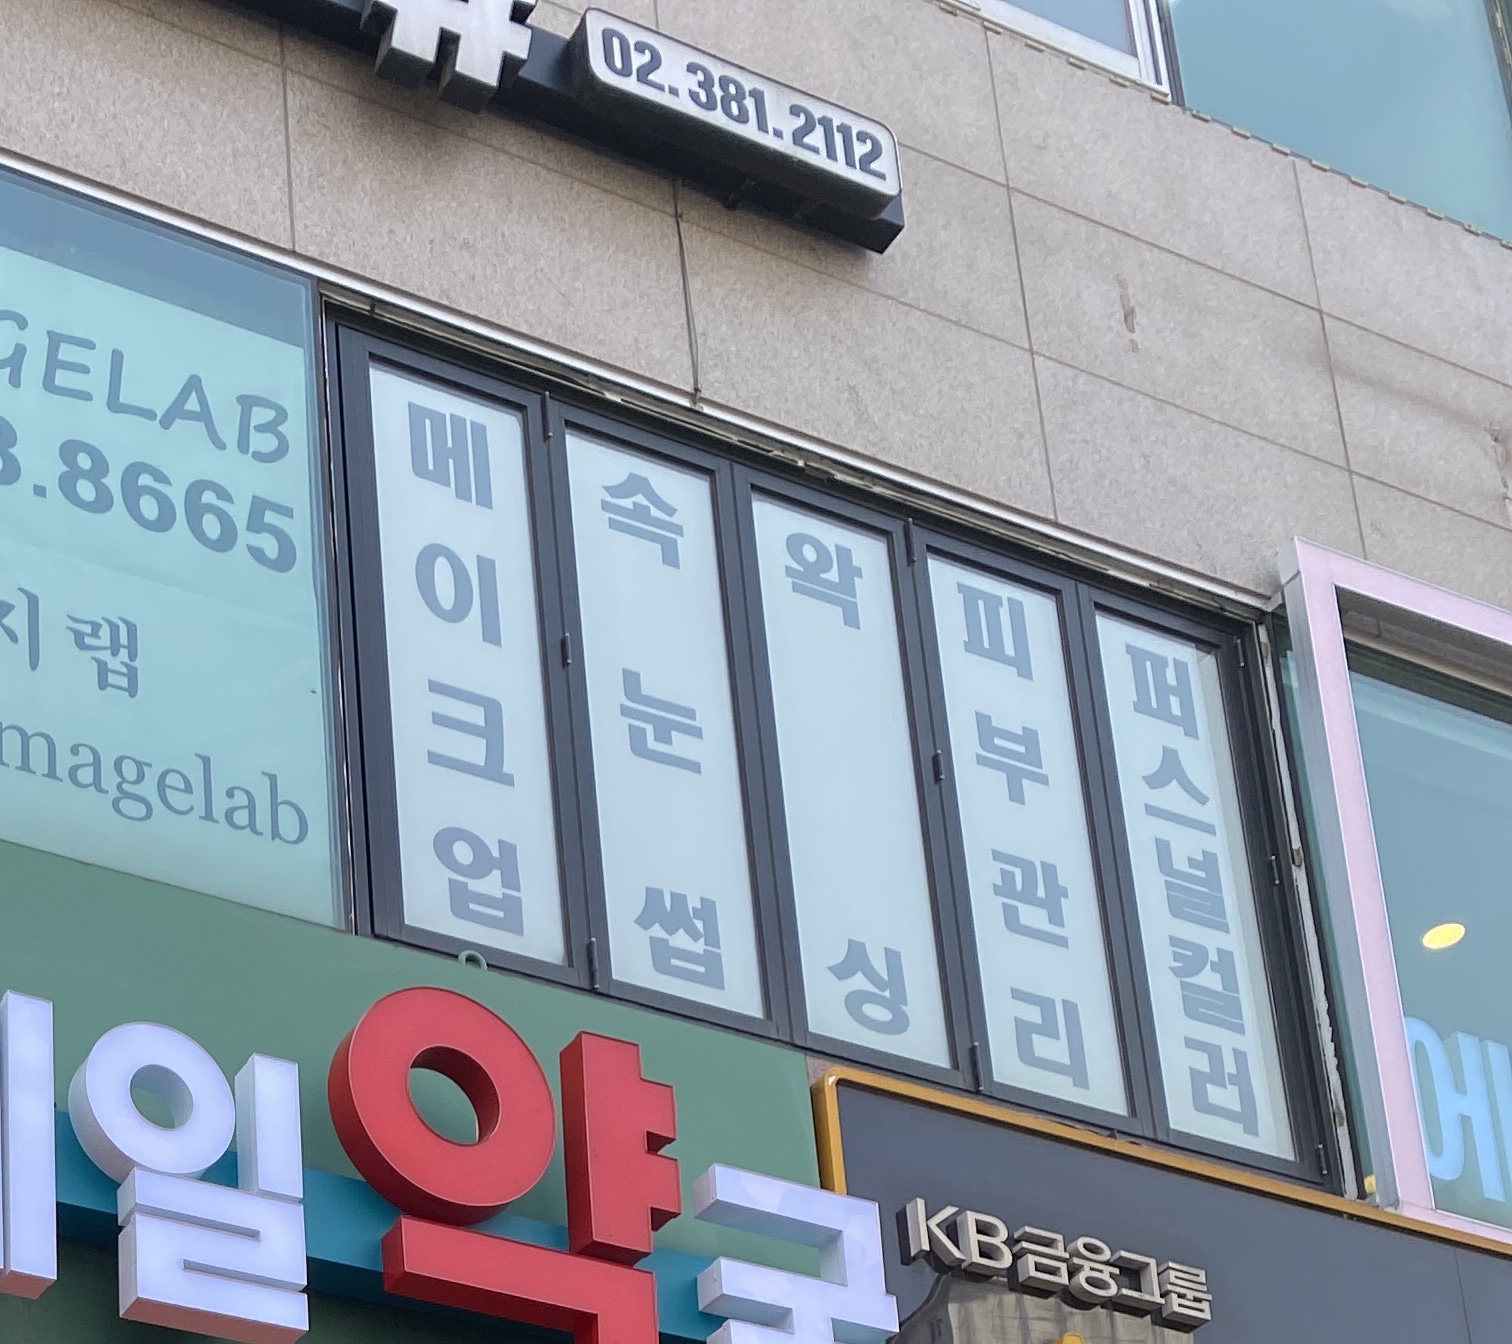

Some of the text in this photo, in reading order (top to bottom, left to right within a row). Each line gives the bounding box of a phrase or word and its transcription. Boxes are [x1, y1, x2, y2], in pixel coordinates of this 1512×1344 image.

[599, 25, 888, 182] 02.381.2112
[407, 401, 526, 938] 메이크업
[599, 470, 727, 991] 속눈썹
[783, 530, 911, 1037] 왁싱
[954, 581, 1091, 1091] 피부관리
[1122, 640, 1260, 1138] 퍼스널컬러
[896, 1197, 1214, 1332] KB금융그룹
